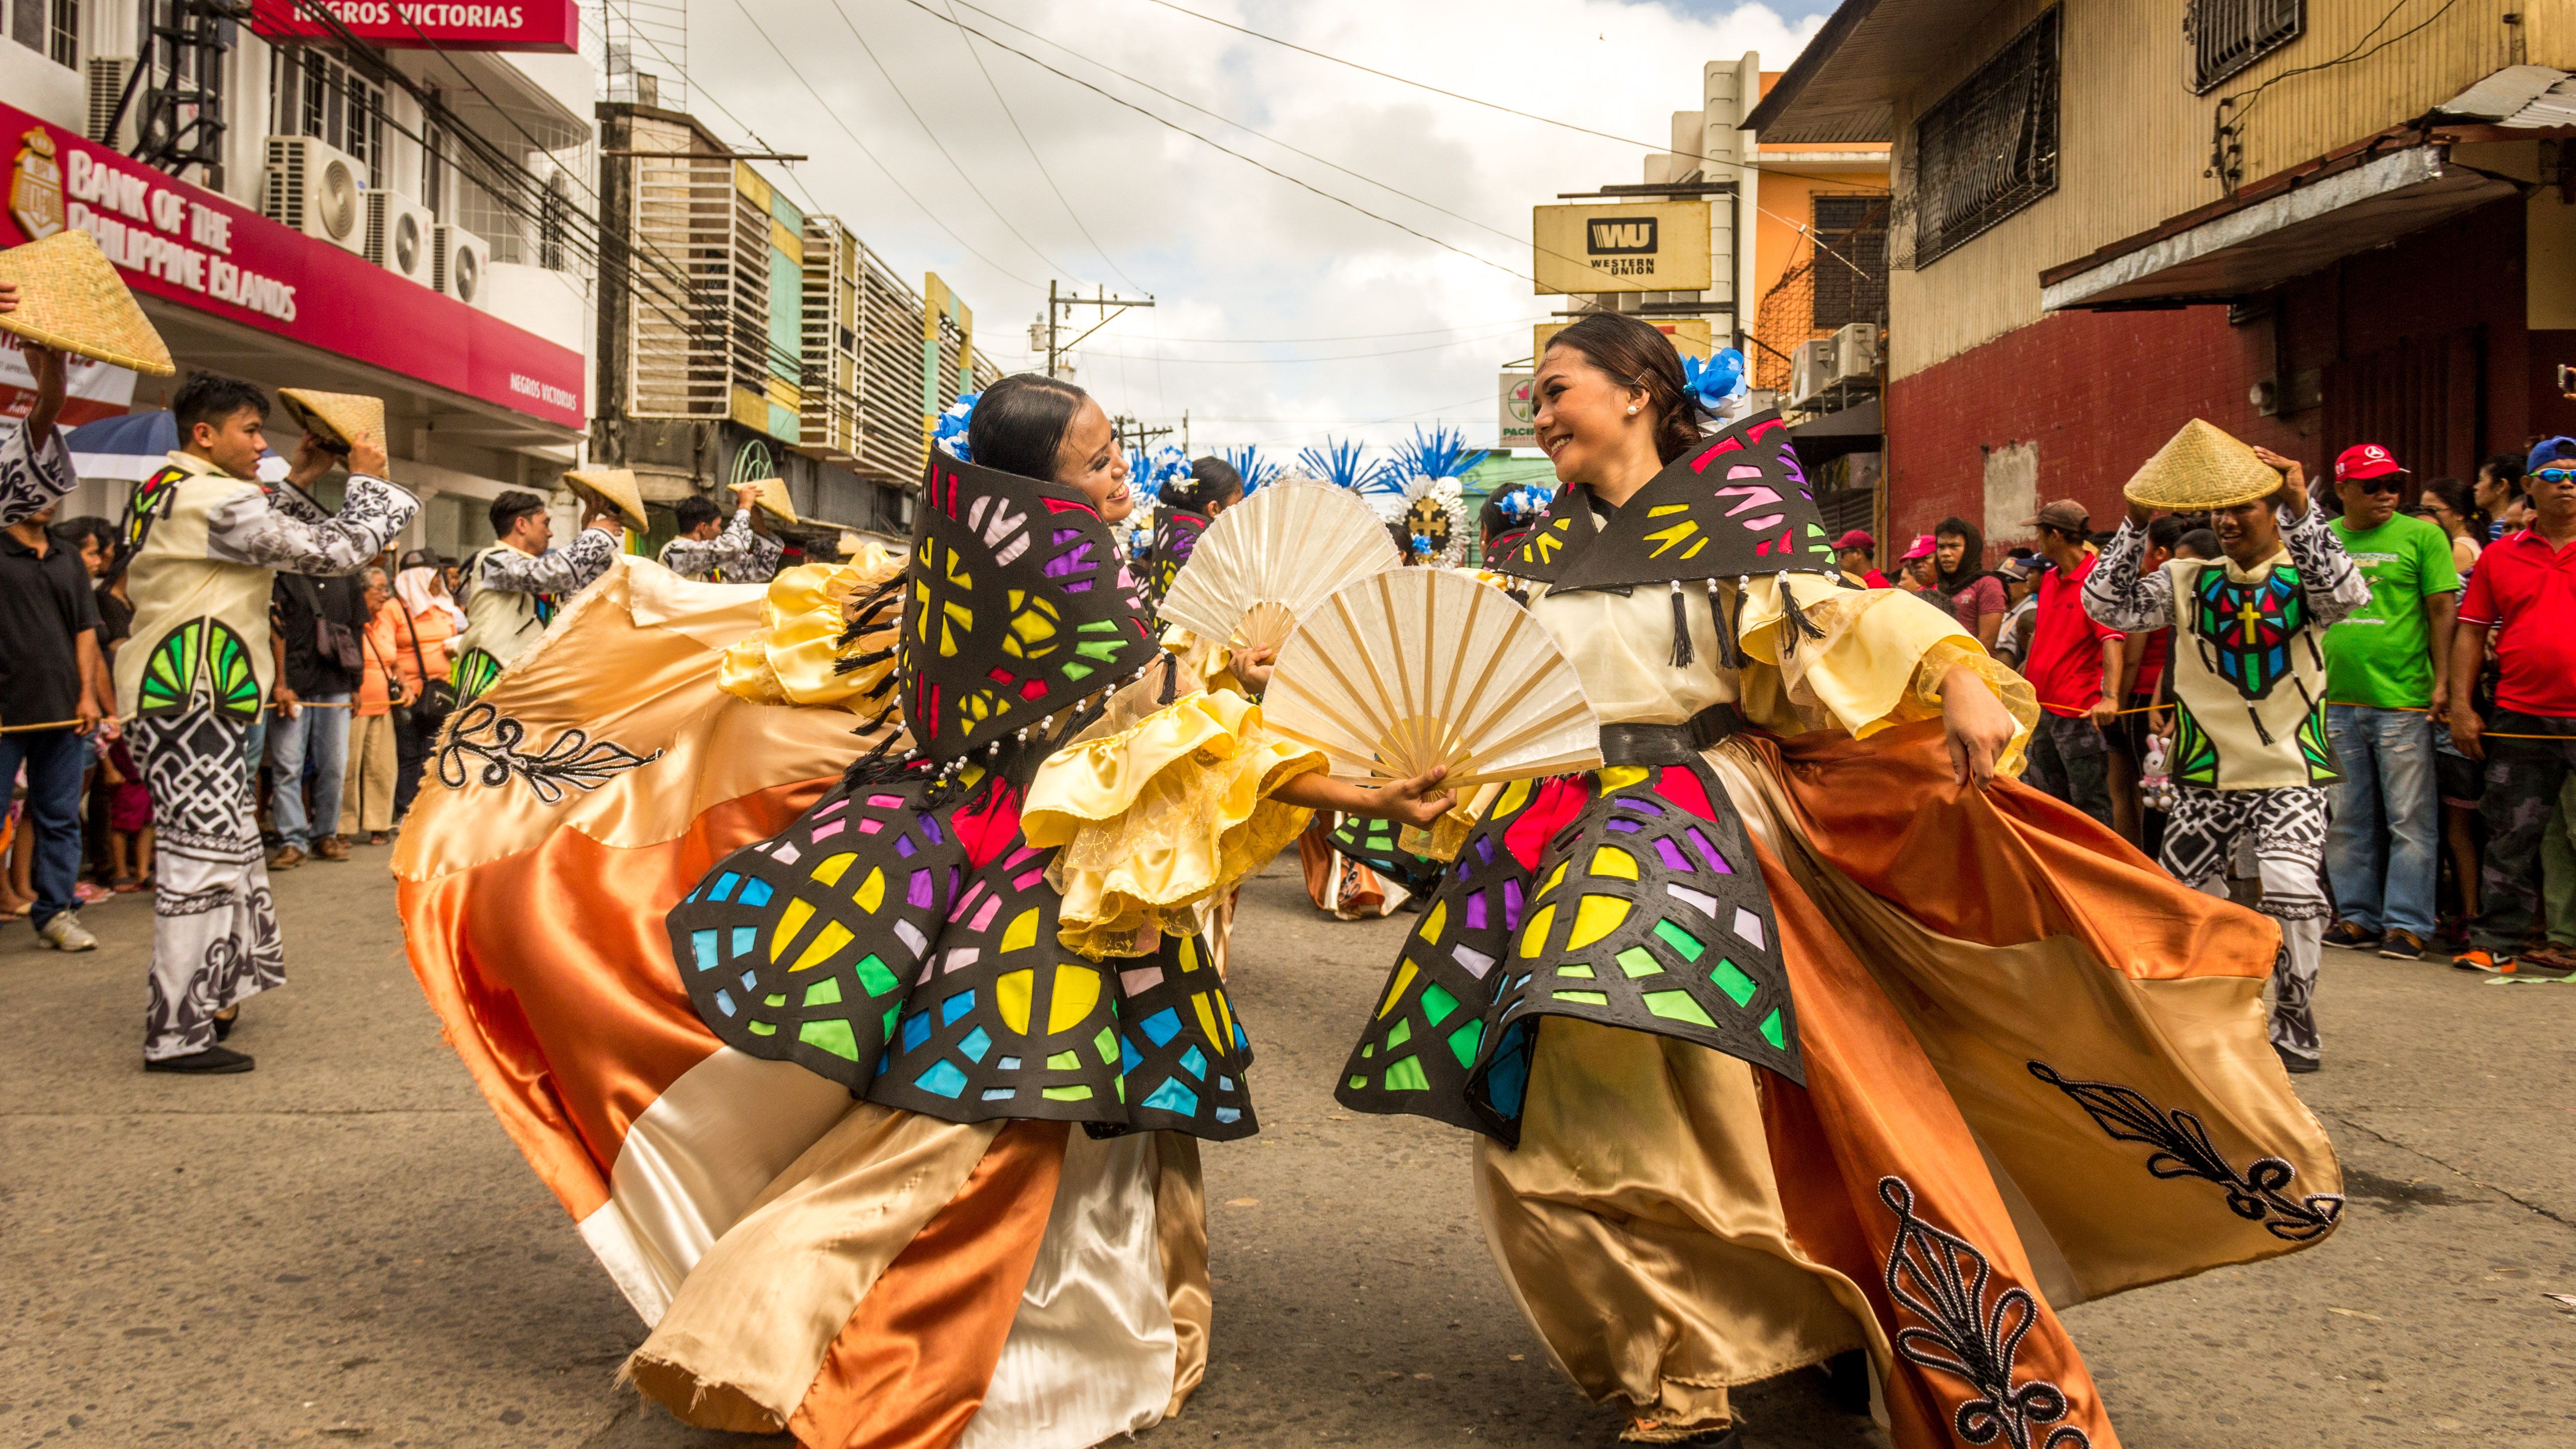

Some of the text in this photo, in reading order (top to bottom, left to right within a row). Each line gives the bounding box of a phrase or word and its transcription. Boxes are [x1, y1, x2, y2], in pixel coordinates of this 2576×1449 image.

[399, 3, 523, 28] VICTORIAS
[68, 150, 233, 254] BANK OF THE
[1593, 224, 1650, 248] WU
[68, 202, 297, 322] PHILIPPINE ISLANDS
[1591, 258, 1654, 267] WESTERN
[1611, 266, 1654, 275] UNION
[510, 373, 576, 411] NEGROS VICTORIAS
